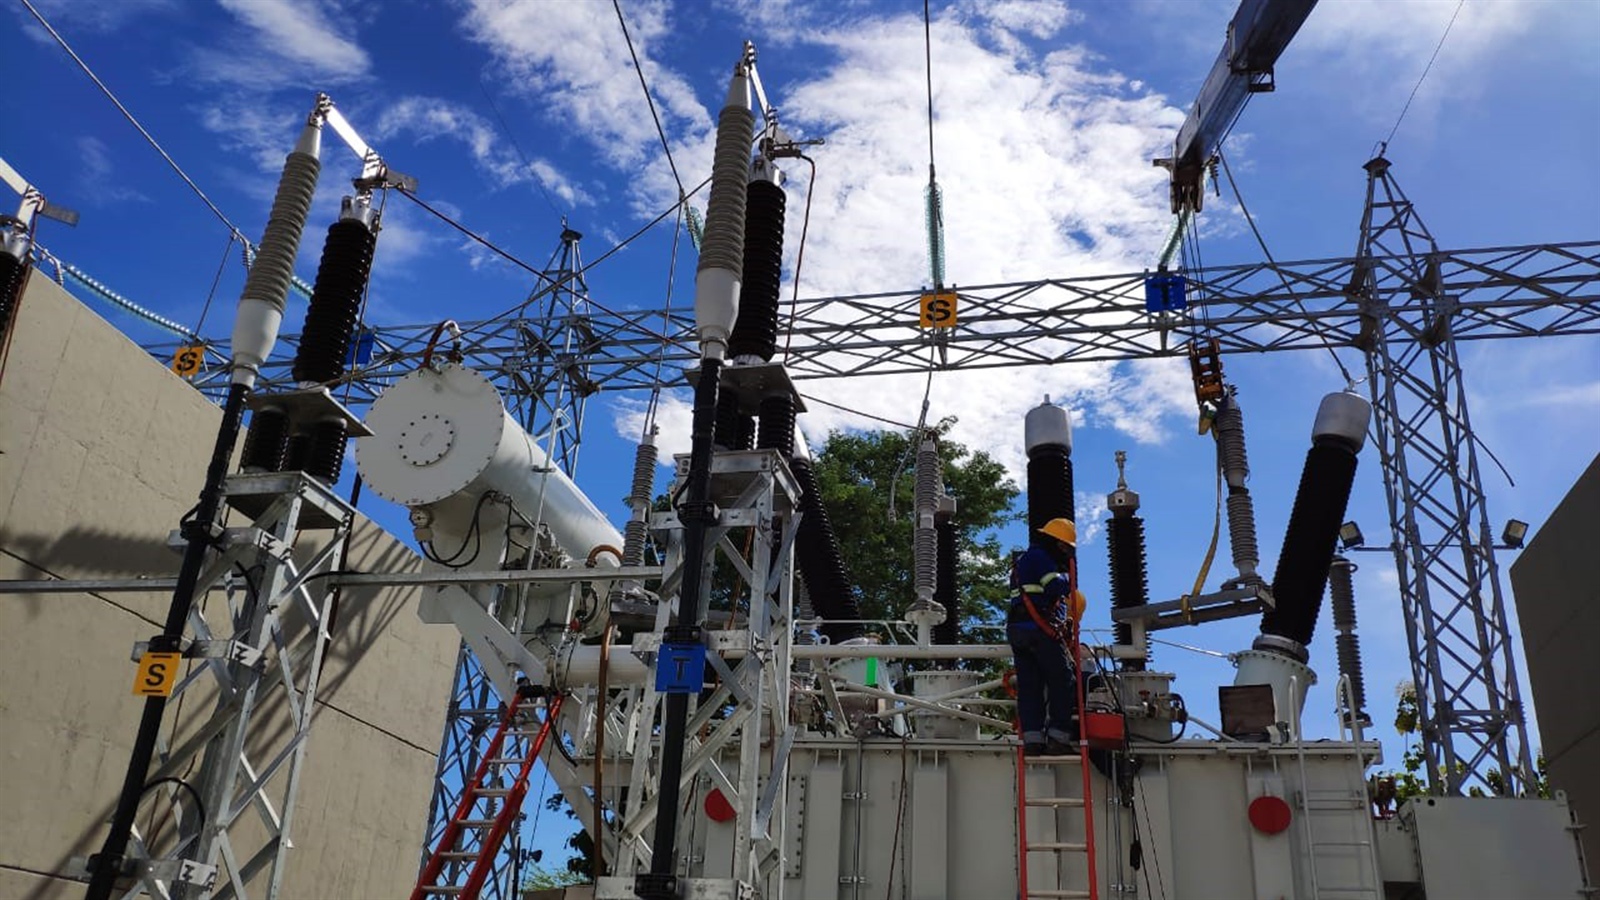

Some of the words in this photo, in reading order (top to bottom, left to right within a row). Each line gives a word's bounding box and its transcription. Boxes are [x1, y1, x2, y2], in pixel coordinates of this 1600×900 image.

[1151, 281, 1176, 307] T
[926, 300, 951, 321] S
[177, 352, 198, 371] S
[145, 663, 166, 686] S
[672, 657, 691, 681] T
